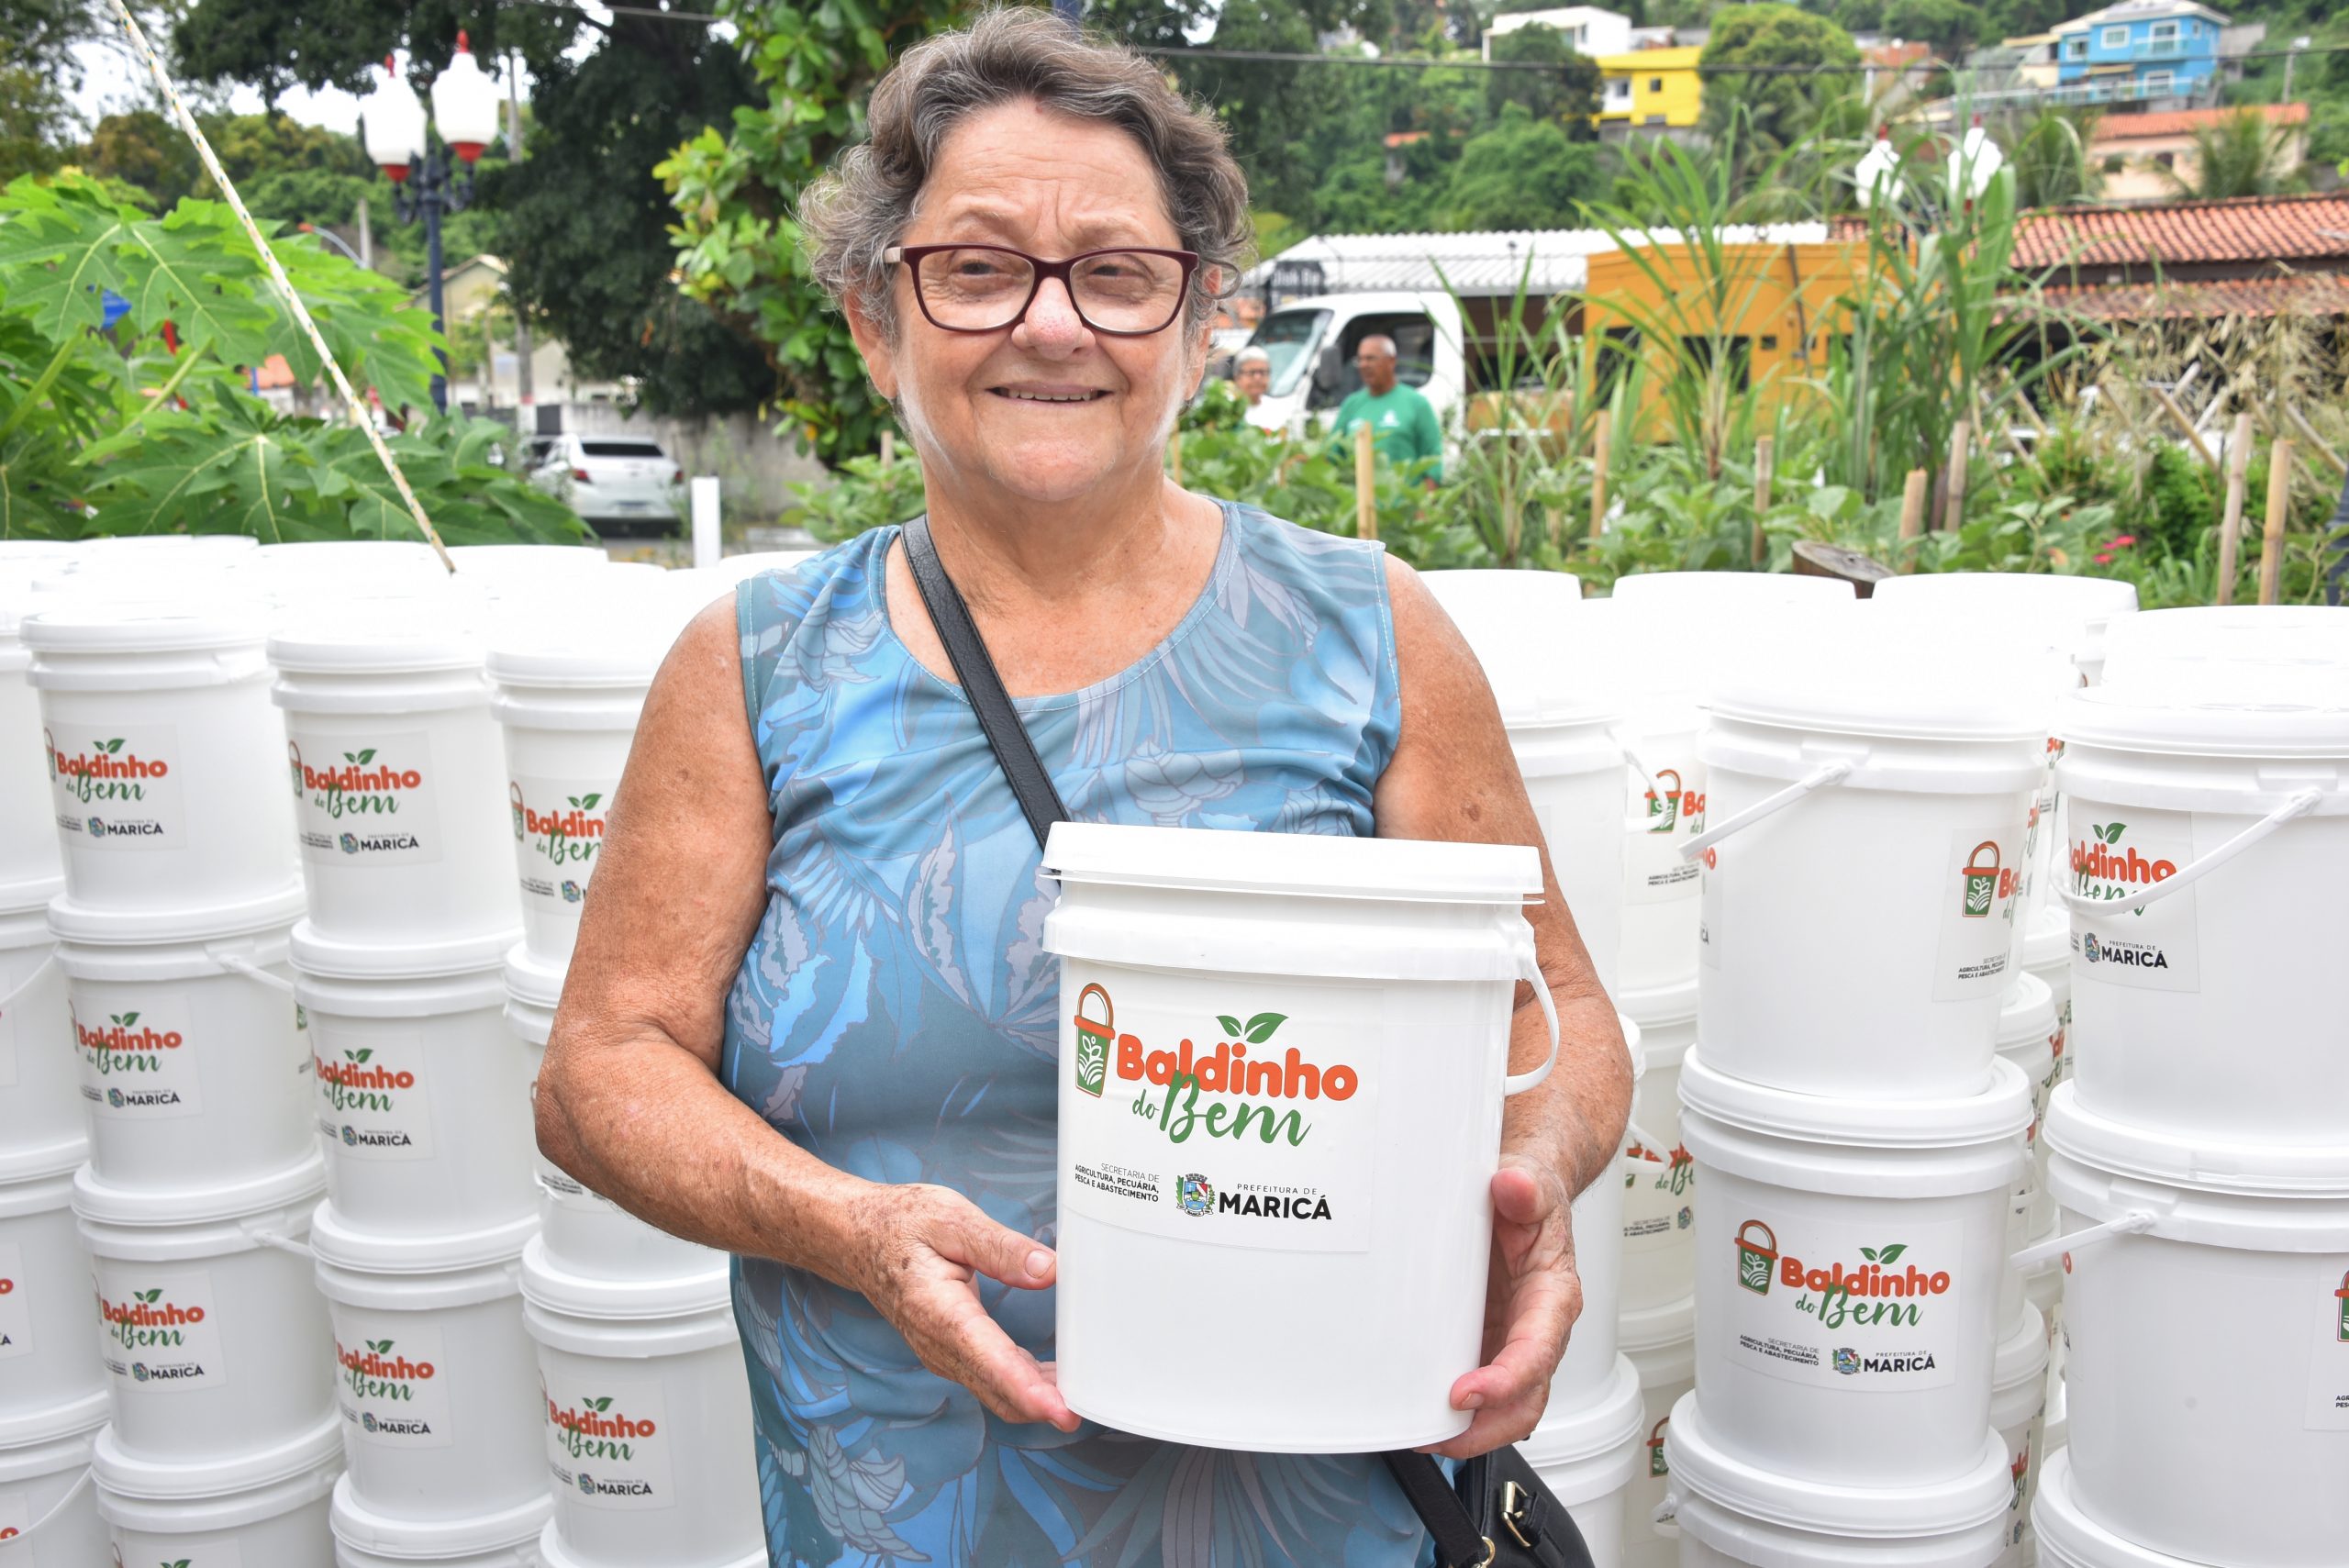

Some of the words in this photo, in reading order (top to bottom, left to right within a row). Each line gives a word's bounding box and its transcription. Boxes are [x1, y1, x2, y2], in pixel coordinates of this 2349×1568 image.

[57, 751, 168, 778] Baldinho
[304, 765, 421, 792] Baldinho
[77, 769, 147, 803] Bem
[328, 783, 400, 818] Bem
[526, 808, 606, 837] Baldin
[2069, 838, 2177, 884] aldinho
[2102, 946, 2168, 969] MARICÁ
[2110, 940, 2143, 950] PREFEITURA
[78, 1023, 183, 1051] Baldinho
[96, 1042, 161, 1074] Bem
[316, 1056, 414, 1089] Baldinho
[1117, 1033, 1358, 1101] Baldinho
[331, 1075, 395, 1112] Bem
[1132, 1089, 1159, 1120] do
[1159, 1070, 1312, 1147] Bem
[1075, 1164, 1116, 1184] AGRICULTURA,
[1118, 1177, 1159, 1194] PECUÁRIA,
[1075, 1173, 1090, 1185] PESCA
[1097, 1182, 1159, 1202] ABASTECIMENTO
[1101, 1163, 1146, 1180] SECRETARIA
[1148, 1173, 1160, 1183] DE
[1237, 1184, 1298, 1194] PREFEITURA
[1219, 1192, 1331, 1220] MARICÁ
[1781, 1256, 1950, 1297] Baldinho
[102, 1298, 205, 1326] Baldinho
[1795, 1294, 1818, 1313] do
[1818, 1282, 1923, 1329] Bem
[120, 1318, 185, 1350] Bem
[1740, 1334, 1782, 1353] AGRICULTURA,
[1784, 1349, 1819, 1361] PECUÁRIA,
[1768, 1338, 1808, 1352] SECRETARIA
[337, 1341, 435, 1379] Baldinho
[1740, 1340, 1757, 1351] PESCA
[1764, 1348, 1819, 1365] ABASTECIMENTO
[1865, 1354, 1935, 1373] MARICÁ
[352, 1365, 415, 1401] Bem
[549, 1399, 656, 1438] Baldinho
[567, 1423, 635, 1461] Bem
